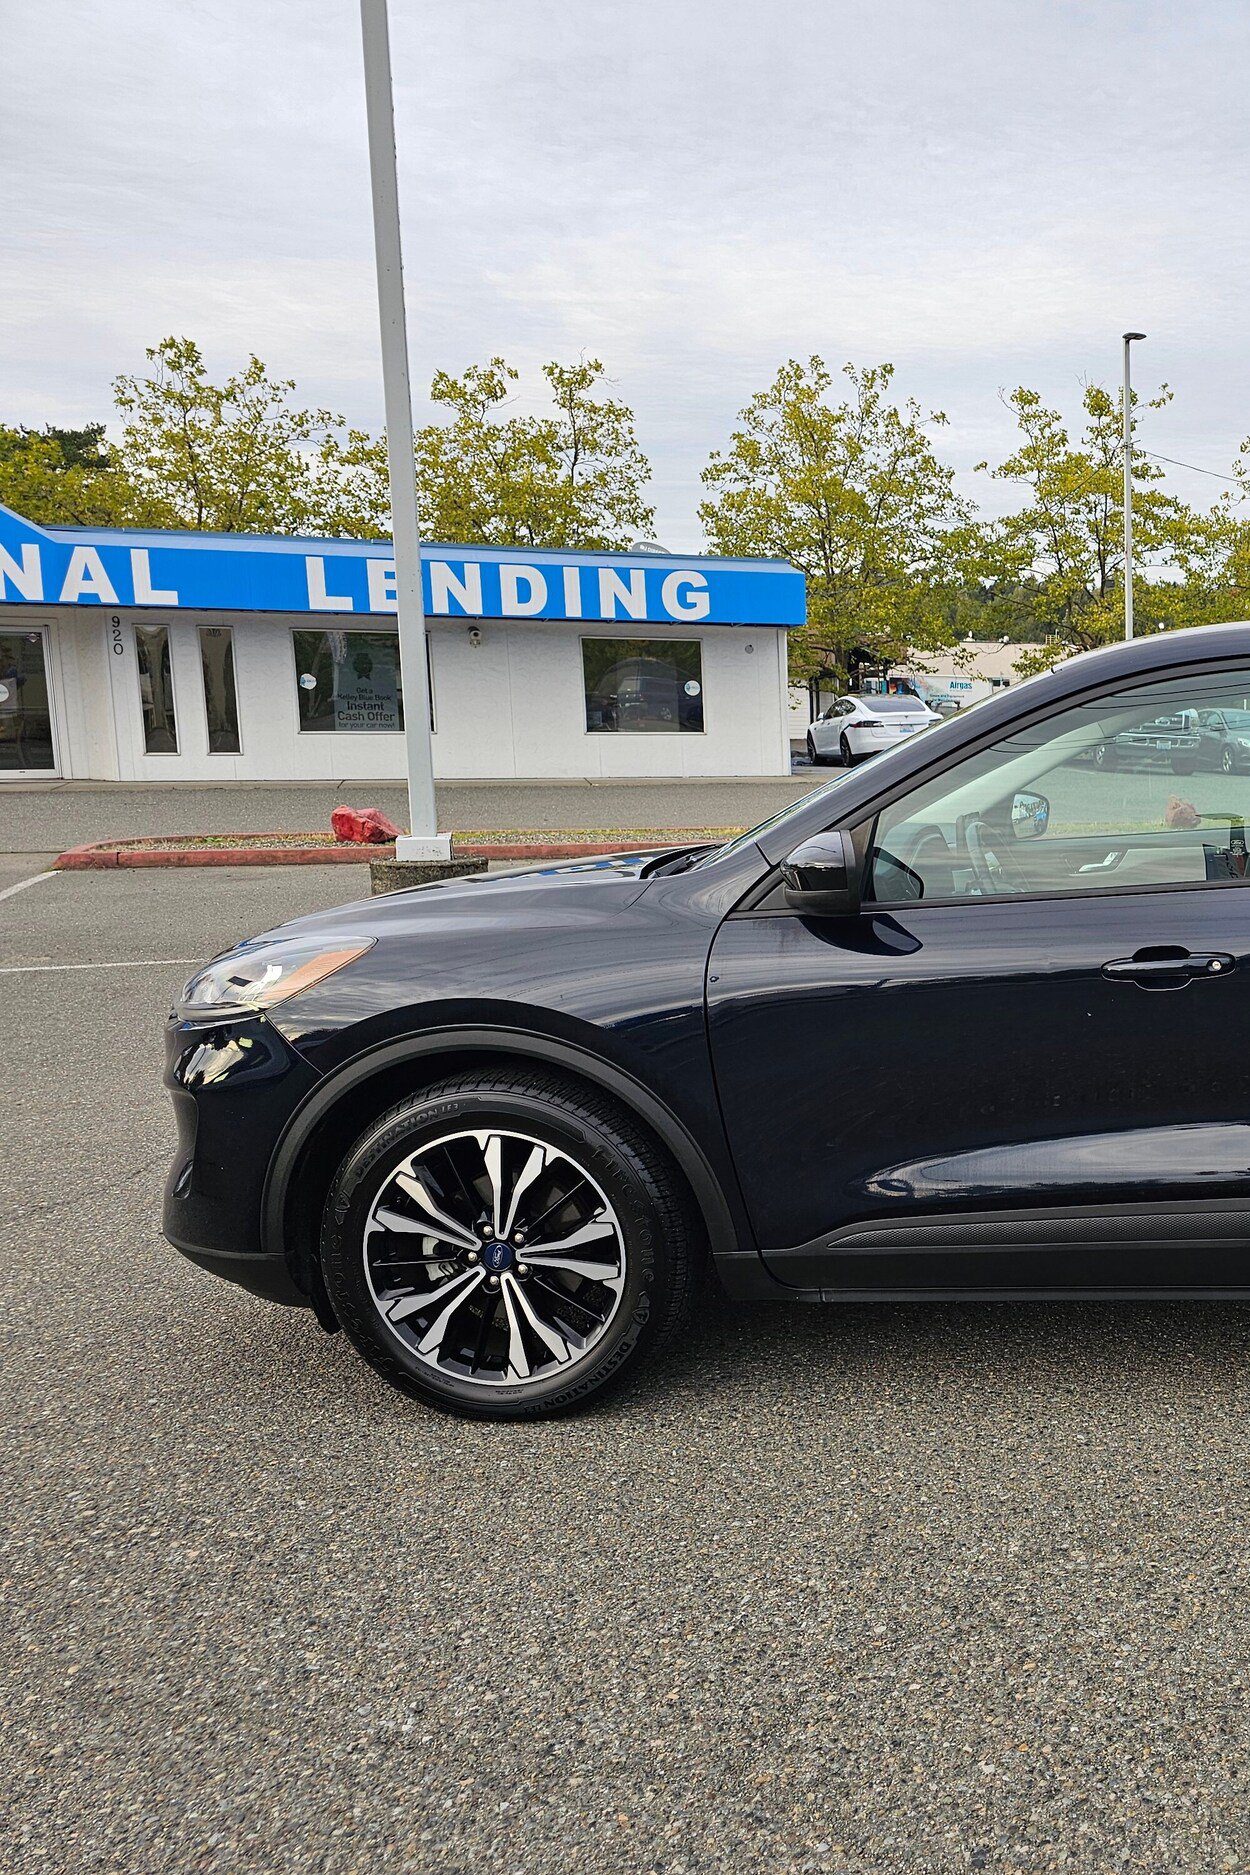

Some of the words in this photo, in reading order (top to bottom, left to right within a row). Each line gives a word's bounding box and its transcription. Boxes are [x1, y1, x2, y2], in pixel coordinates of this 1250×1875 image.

[0, 542, 179, 606] NAL
[305, 556, 710, 621] LENDING
[112, 615, 124, 655] 920
[338, 693, 357, 701] Kelley
[949, 681, 973, 690] Airgas
[337, 711, 365, 721] Cash
[367, 711, 395, 721] Offer
[347, 701, 385, 711] Instant
[355, 1108, 438, 1177] DESTINATION
[544, 1340, 632, 1409] DESTINATION
